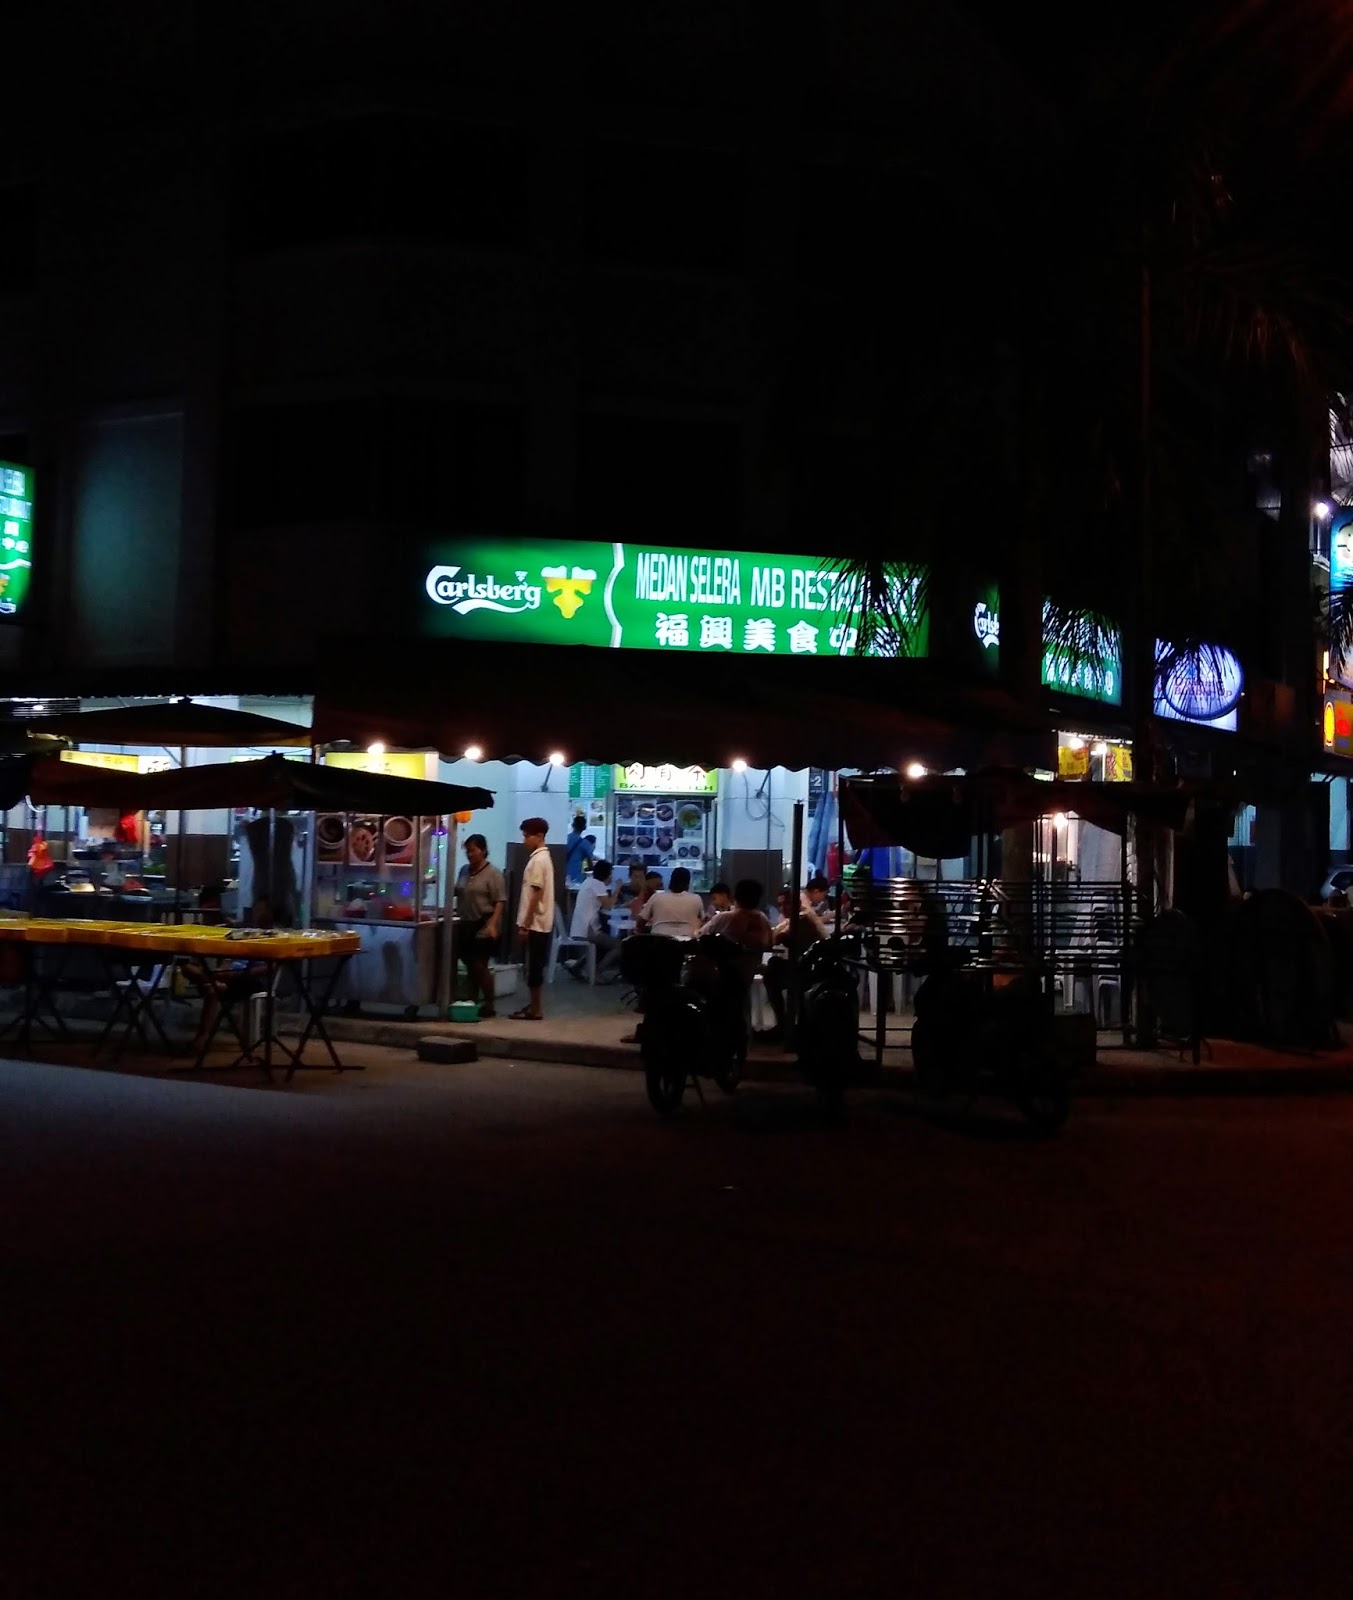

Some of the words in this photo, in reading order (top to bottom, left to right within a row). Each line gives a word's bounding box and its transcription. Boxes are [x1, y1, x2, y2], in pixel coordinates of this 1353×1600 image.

[426, 565, 542, 611] Carlsberg
[635, 552, 688, 602] MEDAN
[690, 556, 741, 605] SELERA
[750, 566, 785, 608] MB
[655, 612, 901, 658] 福興美食中
